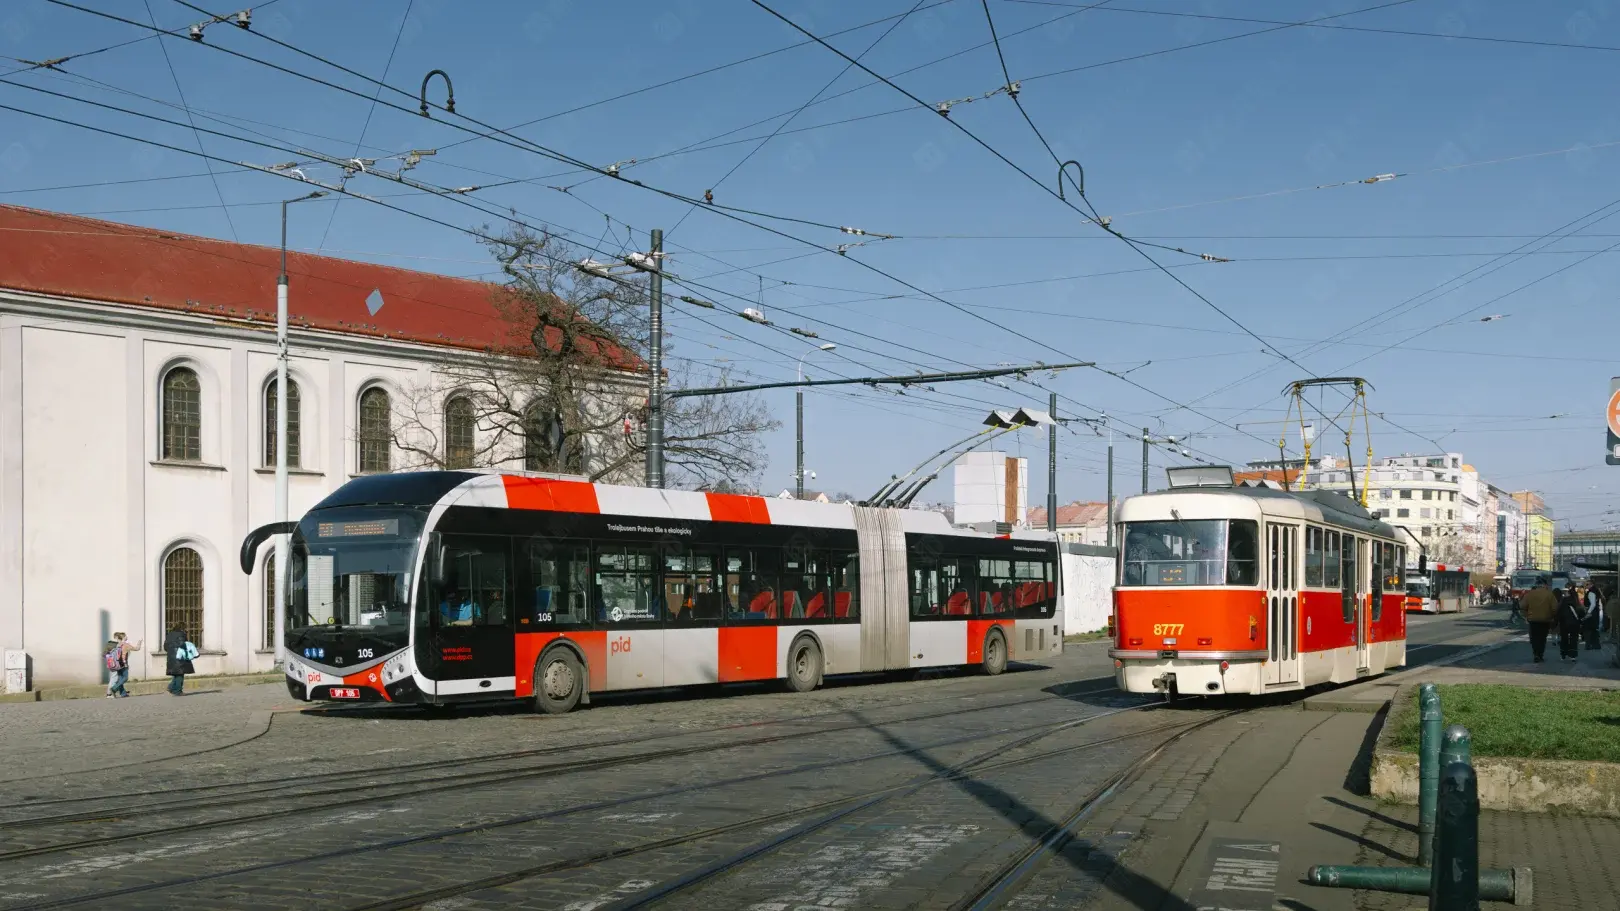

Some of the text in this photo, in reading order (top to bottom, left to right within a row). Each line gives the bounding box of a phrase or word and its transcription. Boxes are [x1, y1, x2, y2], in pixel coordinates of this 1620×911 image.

[538, 613, 552, 622] 105
[1153, 623, 1185, 636] 8777
[357, 648, 374, 658] 105
[611, 636, 631, 657] pid
[307, 671, 322, 684] pid
[1205, 857, 1280, 893] TRAM
